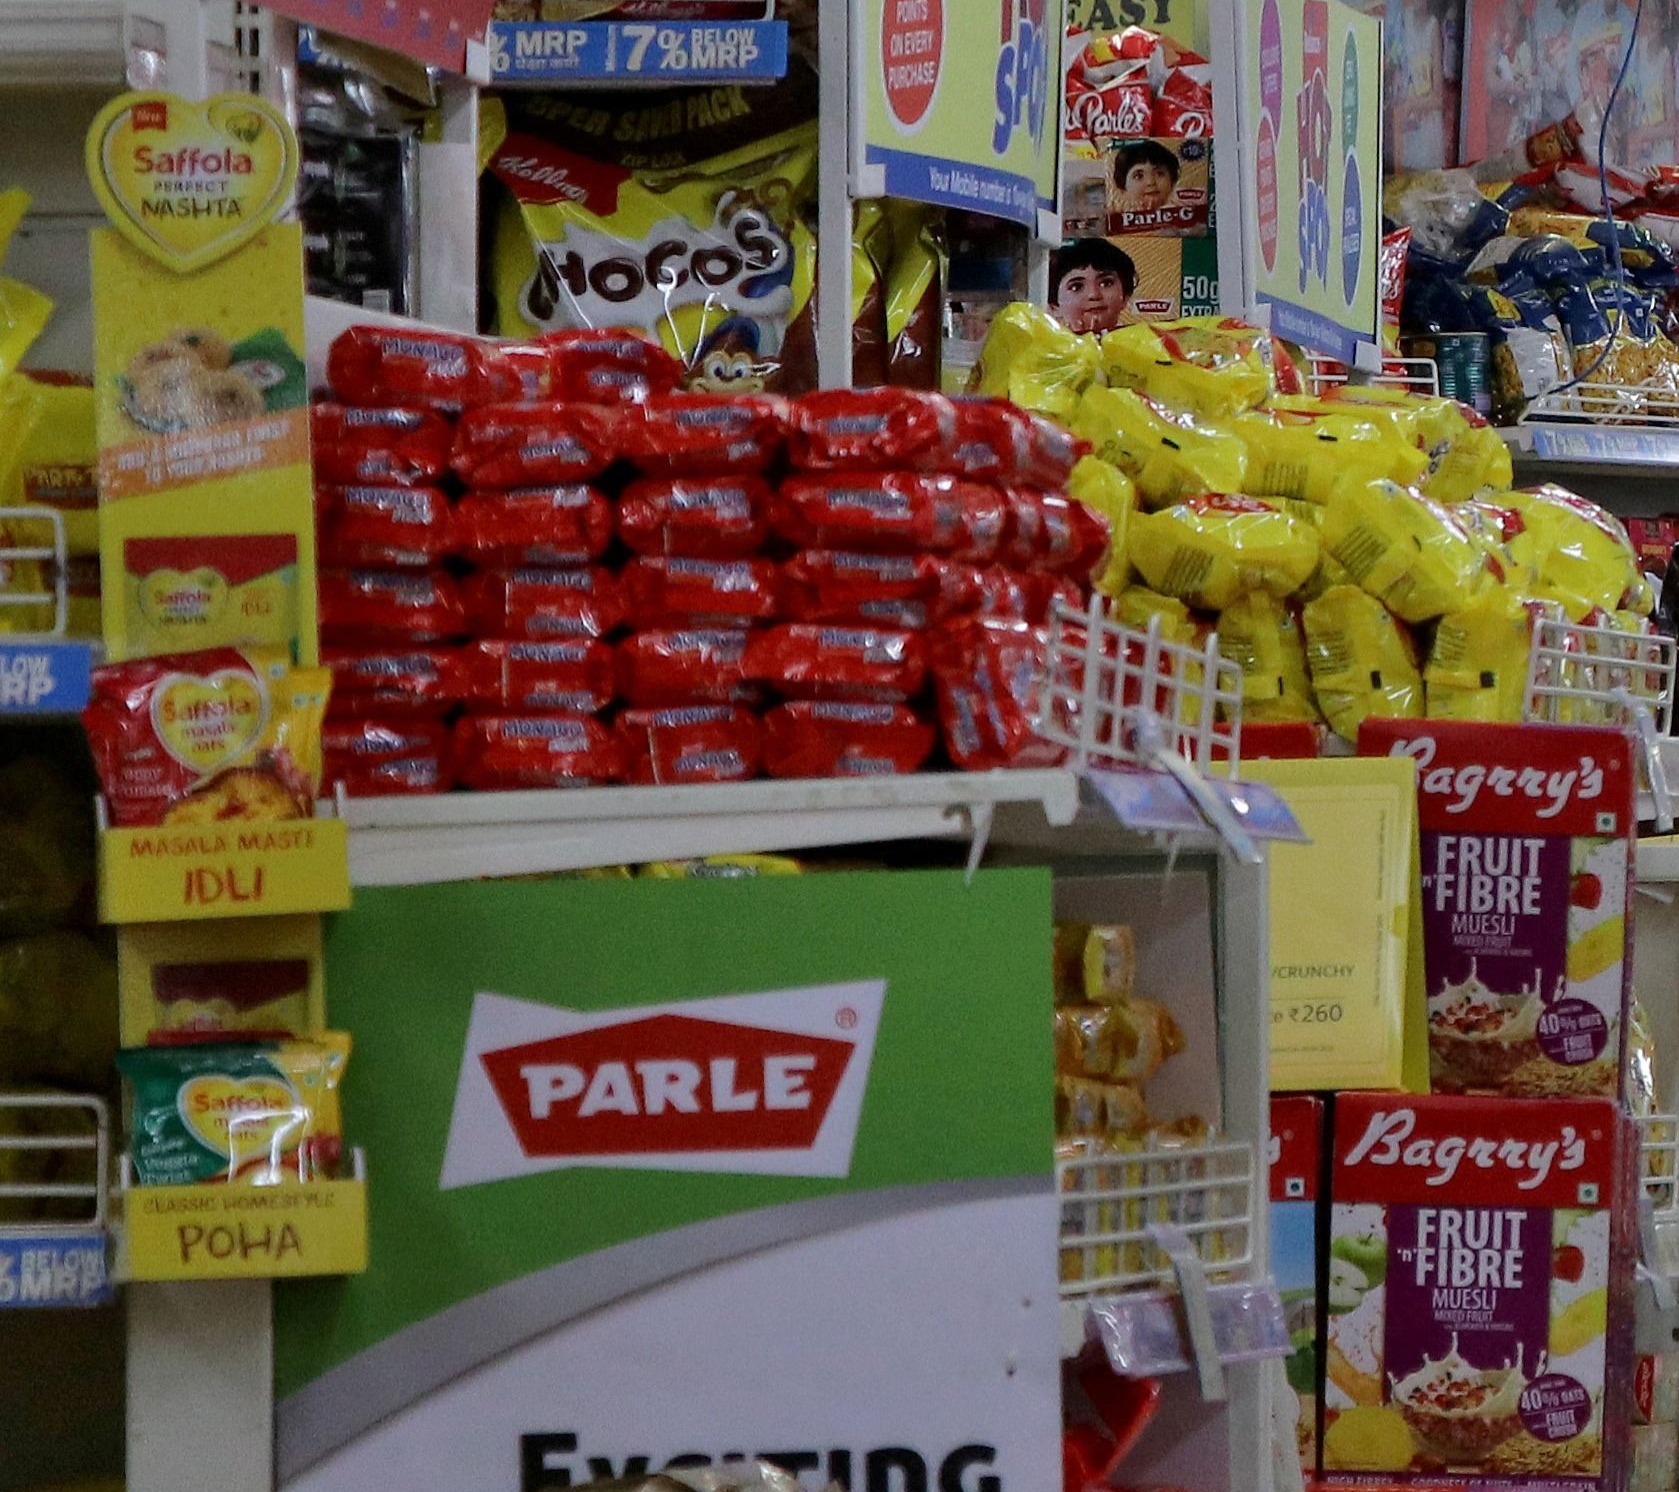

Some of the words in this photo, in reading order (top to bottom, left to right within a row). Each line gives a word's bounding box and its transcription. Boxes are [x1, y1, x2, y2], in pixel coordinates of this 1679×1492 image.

[515, 29, 589, 58] MRP
[691, 27, 756, 46] BELOW
[904, 30, 934, 55] EVERY
[691, 43, 759, 70] MRP
[888, 62, 936, 91] PURCHASE
[686, 84, 751, 132] PACK
[133, 145, 254, 175] Saffola
[153, 180, 230, 194] PERFECT
[141, 197, 244, 220] NASHTA
[1120, 206, 1194, 228] Parle-G
[0, 674, 55, 704] RP
[1388, 735, 1605, 819] Bagrry's
[131, 834, 227, 858] MASALA
[237, 829, 315, 851] MASTI
[1436, 835, 1547, 879] FRUIT
[184, 865, 265, 905] IDLI
[1435, 873, 1544, 915] FIBRE
[1451, 913, 1516, 936] MUESLI
[1287, 1003, 1344, 1025] ₹260
[520, 1053, 817, 1120] PARLE
[1343, 1108, 1586, 1190] Bagrry's
[177, 1221, 302, 1264] POHA
[1416, 1209, 1528, 1252] FRUIT
[1415, 1248, 1524, 1291] FIBRE
[1431, 1288, 1498, 1311] MUESLI
